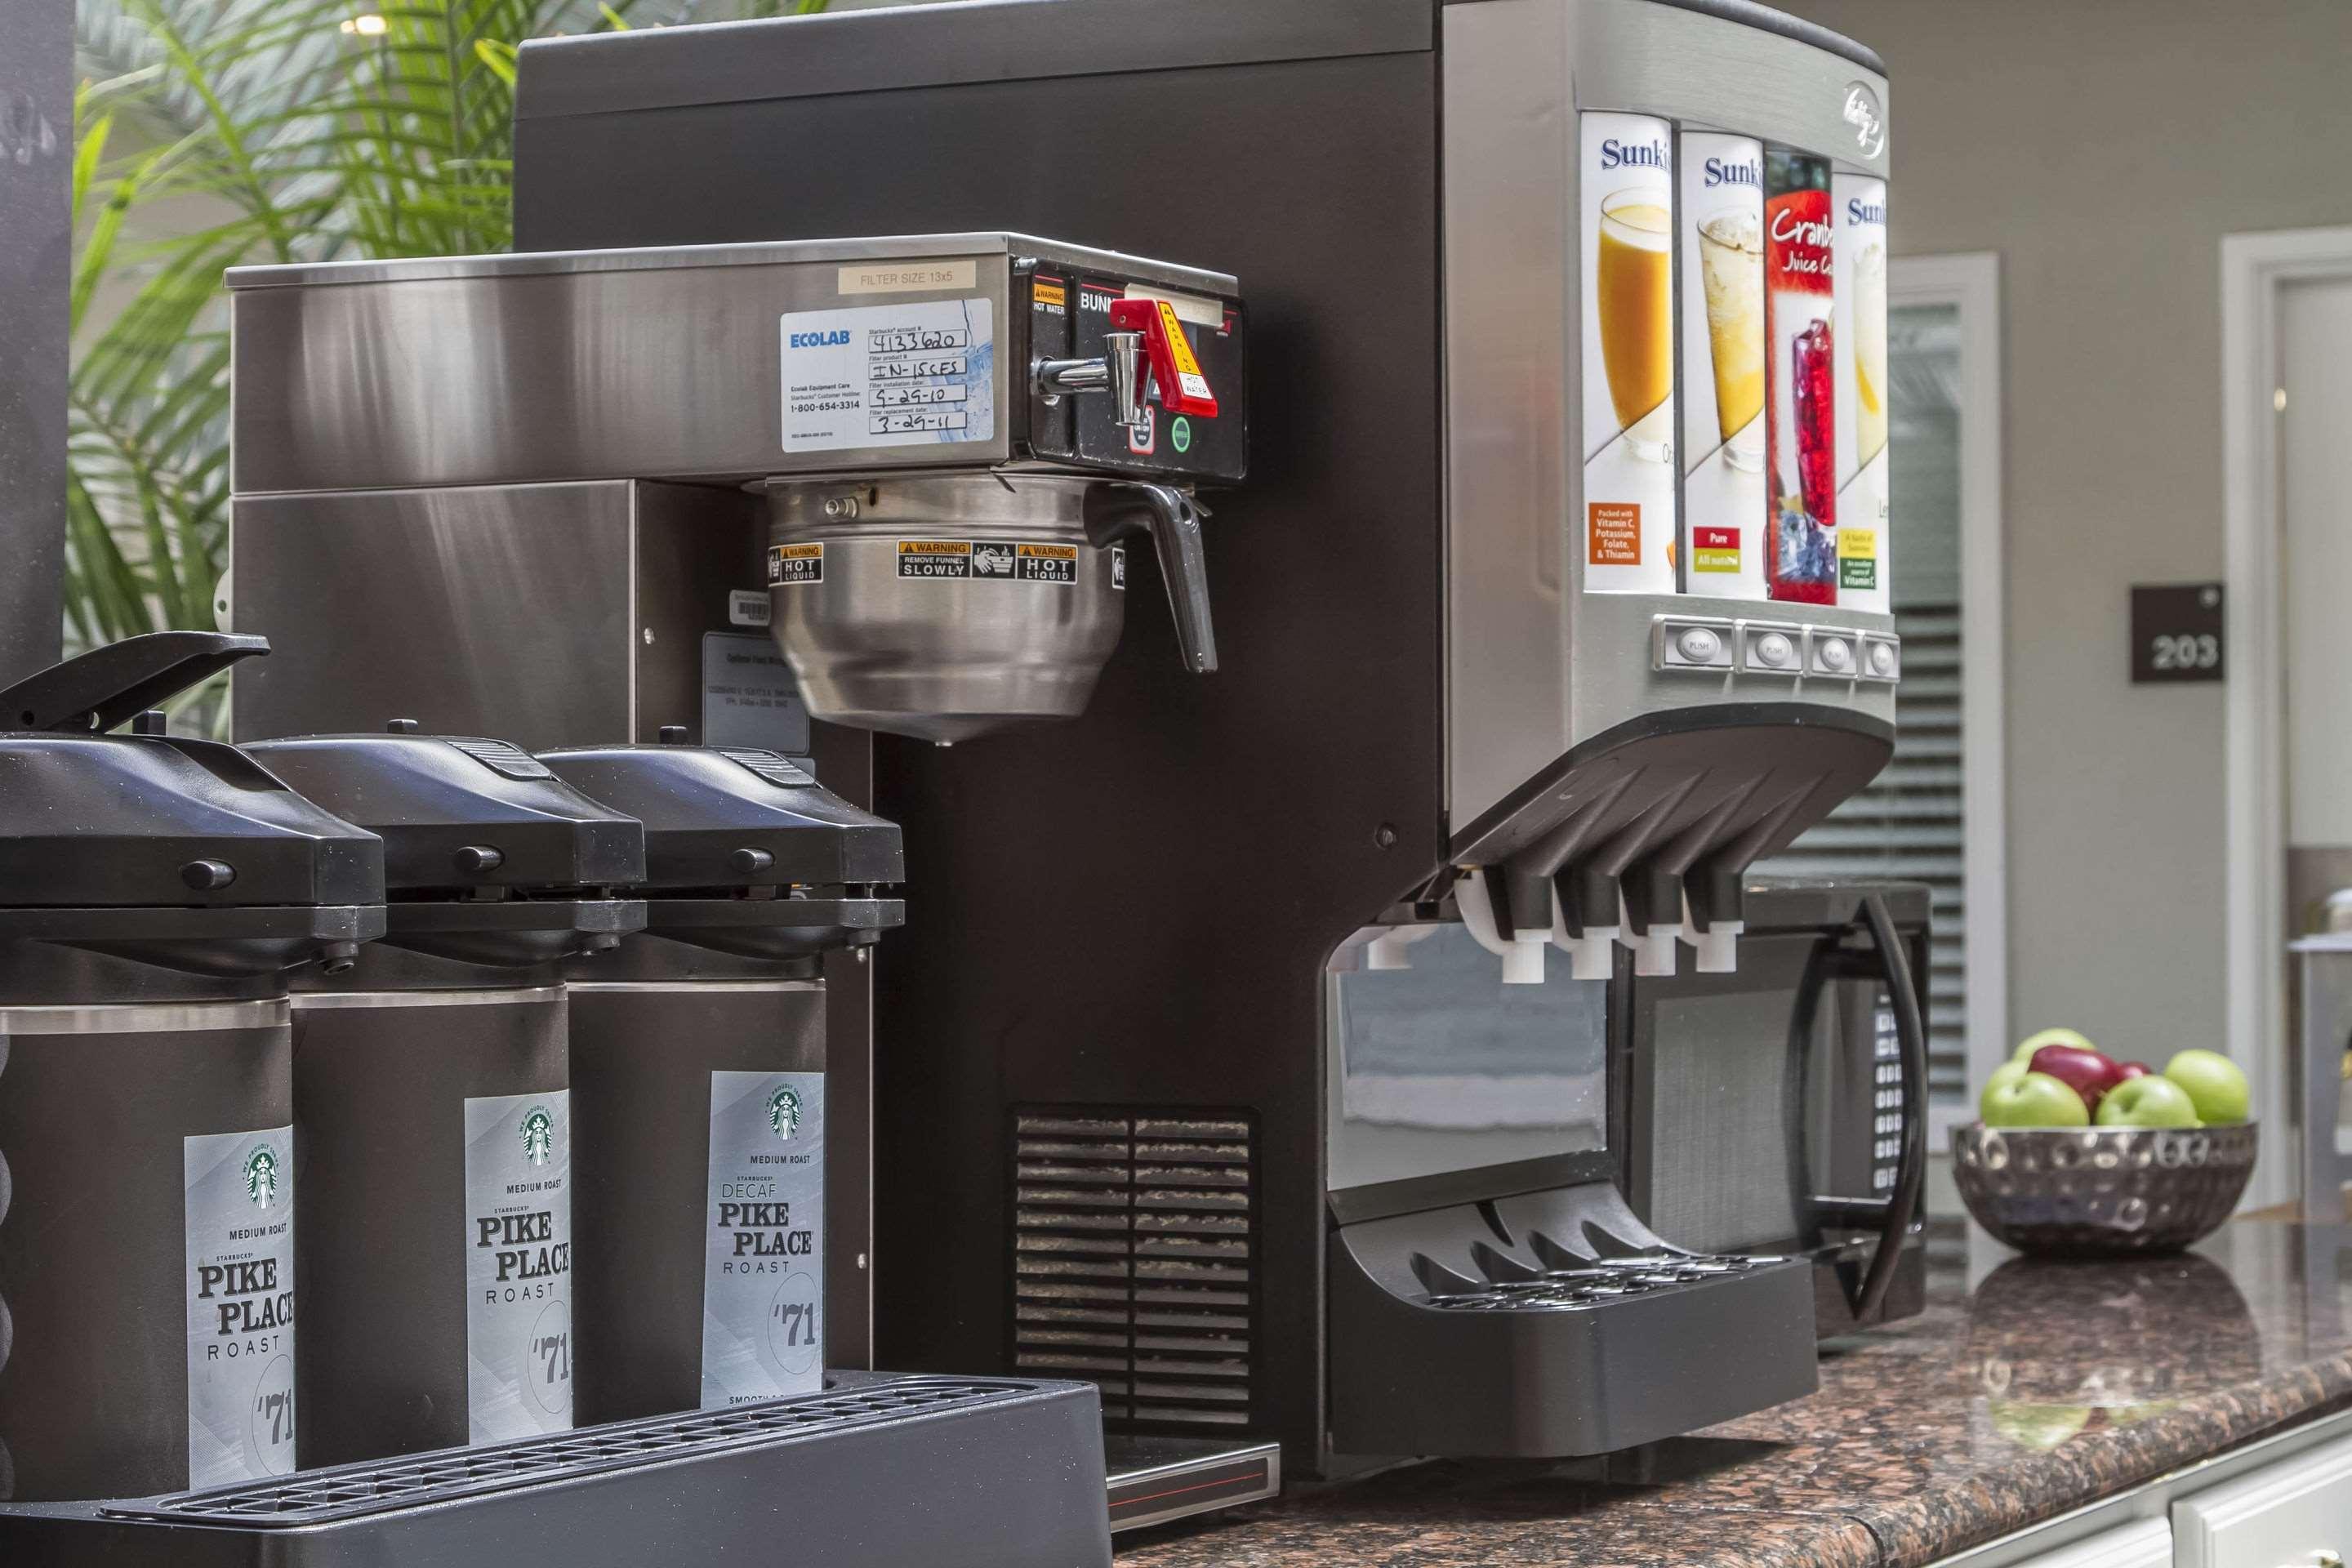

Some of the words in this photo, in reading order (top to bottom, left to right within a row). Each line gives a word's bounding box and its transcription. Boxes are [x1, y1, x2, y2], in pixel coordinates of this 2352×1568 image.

[1782, 250, 1818, 273] Juice
[861, 274, 898, 286] FILTER
[901, 273, 926, 284] SIZE
[930, 270, 953, 283] 13x5
[1040, 290, 1063, 301] WARNING
[1033, 301, 1045, 312] HOT
[1046, 305, 1065, 314] WATER
[790, 330, 851, 349] ECOLAB
[874, 331, 955, 352] 4133620
[791, 400, 860, 412] 1-800-654-3314
[878, 414, 949, 433] 3-29-11
[1598, 509, 1620, 517] Packed
[1597, 518, 1627, 528] Vitamin
[1596, 528, 1636, 540] Potassium,
[1710, 532, 1727, 544] Pure
[789, 546, 819, 557] WARNING
[916, 543, 967, 553] WARNING
[1034, 546, 1073, 557] WARNING
[1597, 549, 1603, 559] &
[1605, 550, 1635, 559] Thiamin
[785, 560, 815, 572] HOT
[1027, 559, 1070, 572] HOT
[1698, 555, 1710, 565] All
[785, 571, 815, 581] LIQUID
[903, 564, 964, 576] SLOWLY
[1027, 570, 1069, 581] LIQUID
[1844, 575, 1869, 586] Vitamin
[1689, 642, 1709, 651] PUSH
[1766, 646, 1783, 654] PUSH
[2151, 634, 2219, 670] 203
[751, 1156, 786, 1164] MEDIUM
[790, 1155, 810, 1164] ROAST
[506, 1182, 541, 1195] MEDIUM
[544, 1178, 562, 1190] ROAST
[721, 1183, 777, 1198] DECAF
[718, 1202, 789, 1228] PIKE
[229, 1227, 266, 1241] MEDIUM
[269, 1223, 287, 1236] ROAST
[476, 1210, 551, 1248] PIKE
[733, 1230, 812, 1257] PLACE
[495, 1241, 569, 1282] PLACE
[723, 1261, 791, 1274] ROAST
[197, 1258, 278, 1299] PIKE
[486, 1282, 554, 1304] ROAST
[773, 1302, 816, 1346] '71
[207, 1335, 279, 1361] ROAST
[533, 1332, 569, 1384] '71
[257, 1388, 293, 1446] '71
